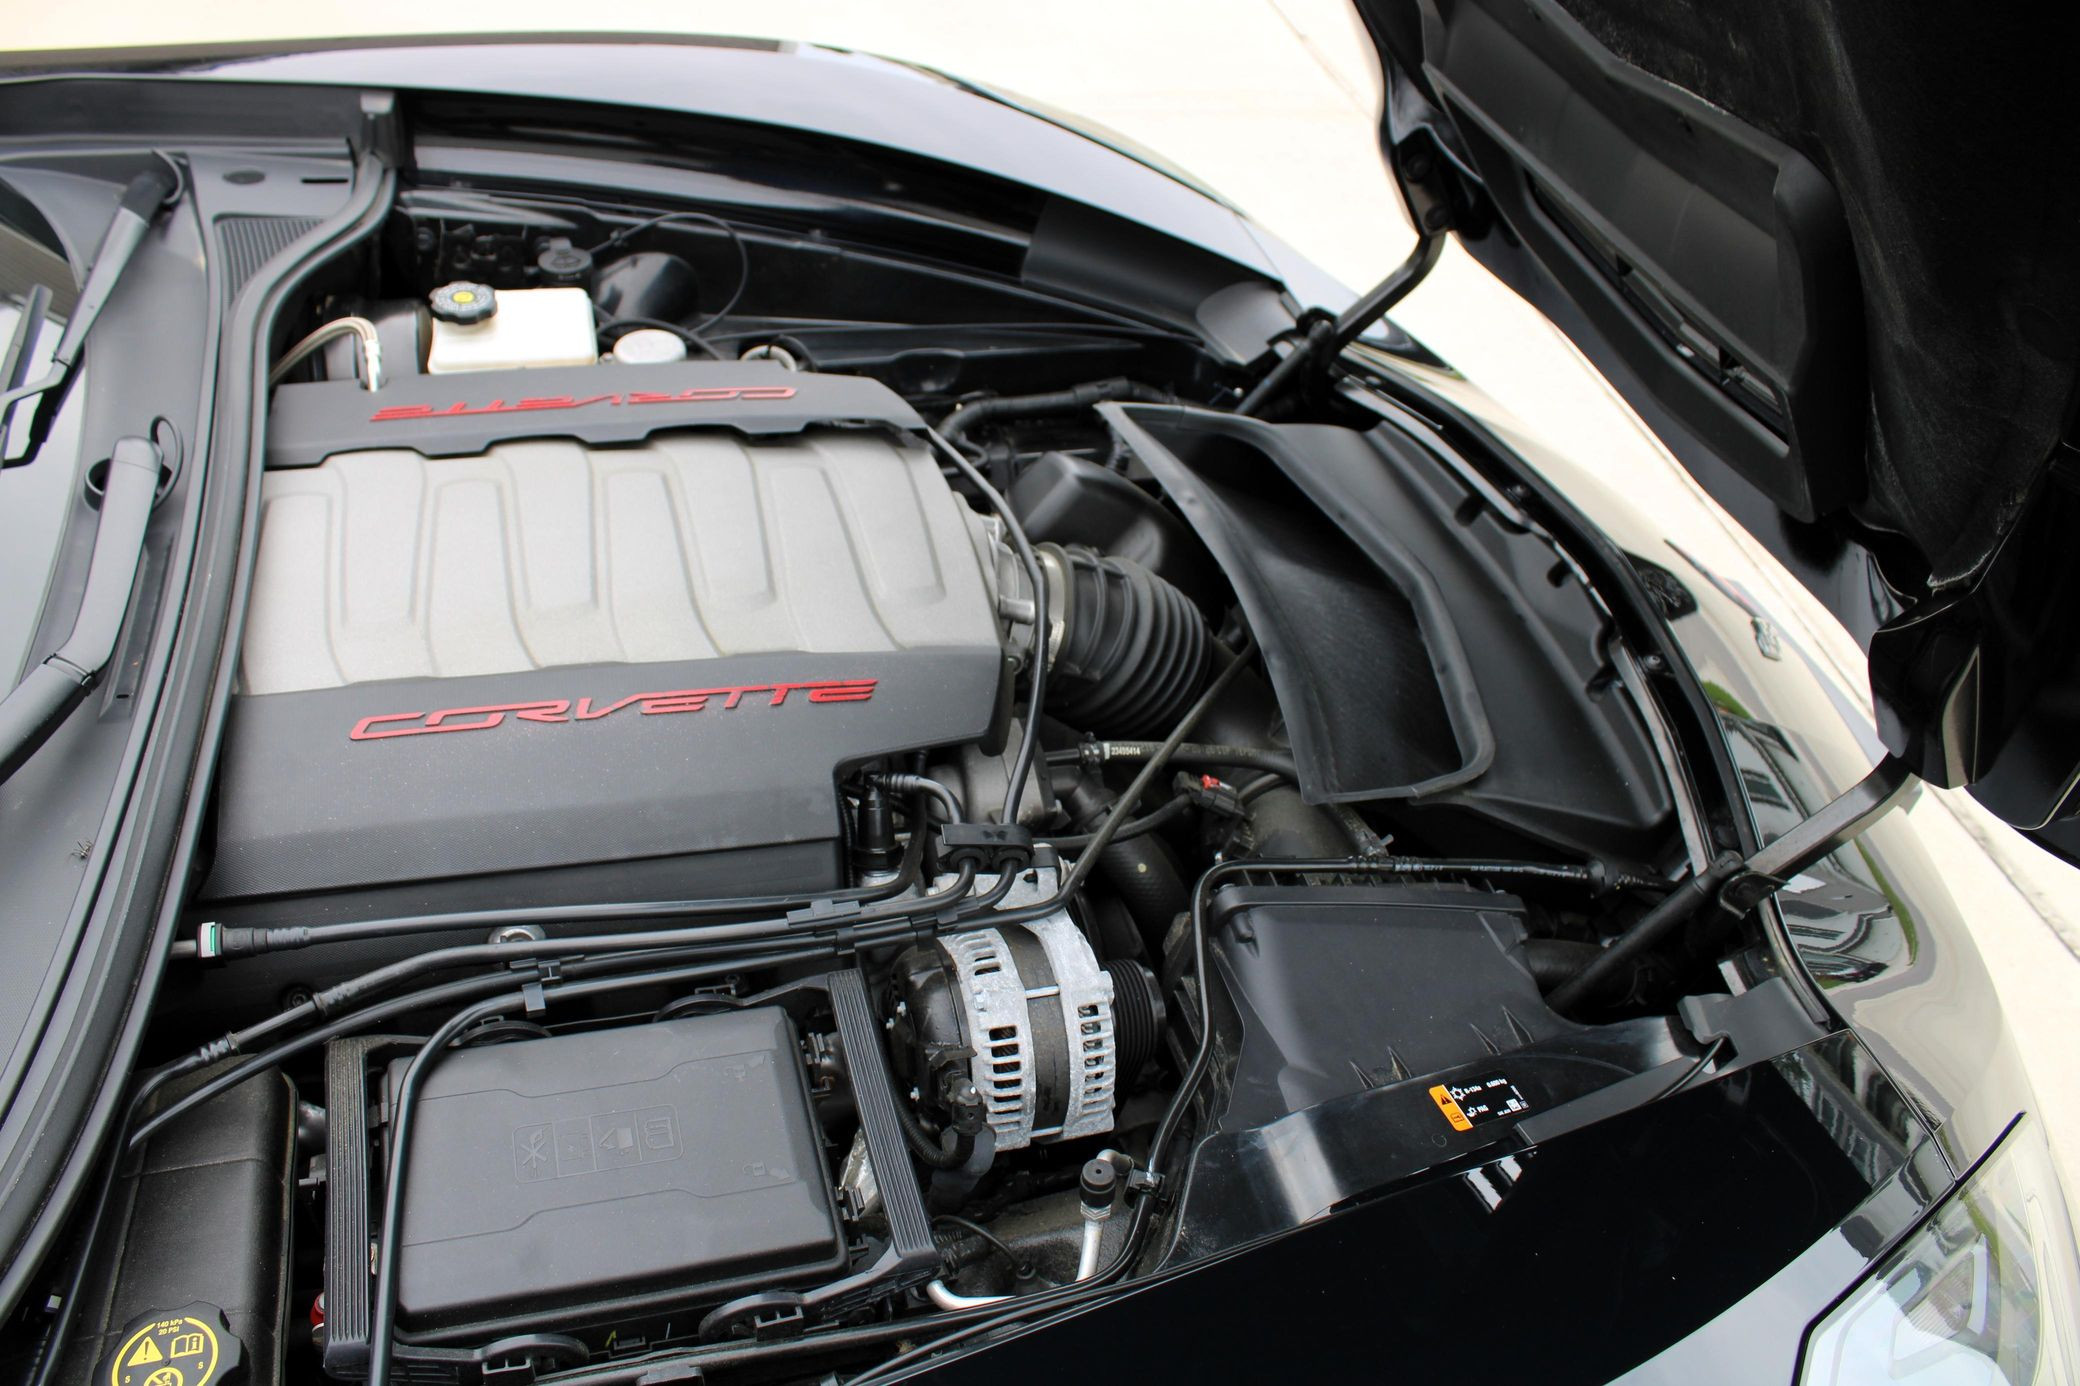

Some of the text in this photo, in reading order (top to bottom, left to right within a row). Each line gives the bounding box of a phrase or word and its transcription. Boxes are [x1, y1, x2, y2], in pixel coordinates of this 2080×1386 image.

[369, 387, 797, 422] CORVETTE
[349, 679, 878, 740] CORVETTE
[157, 1318, 183, 1329] 140 kPa
[158, 1325, 180, 1336] 20 PSI
[197, 1361, 204, 1369] S
[124, 1375, 131, 1384] S
